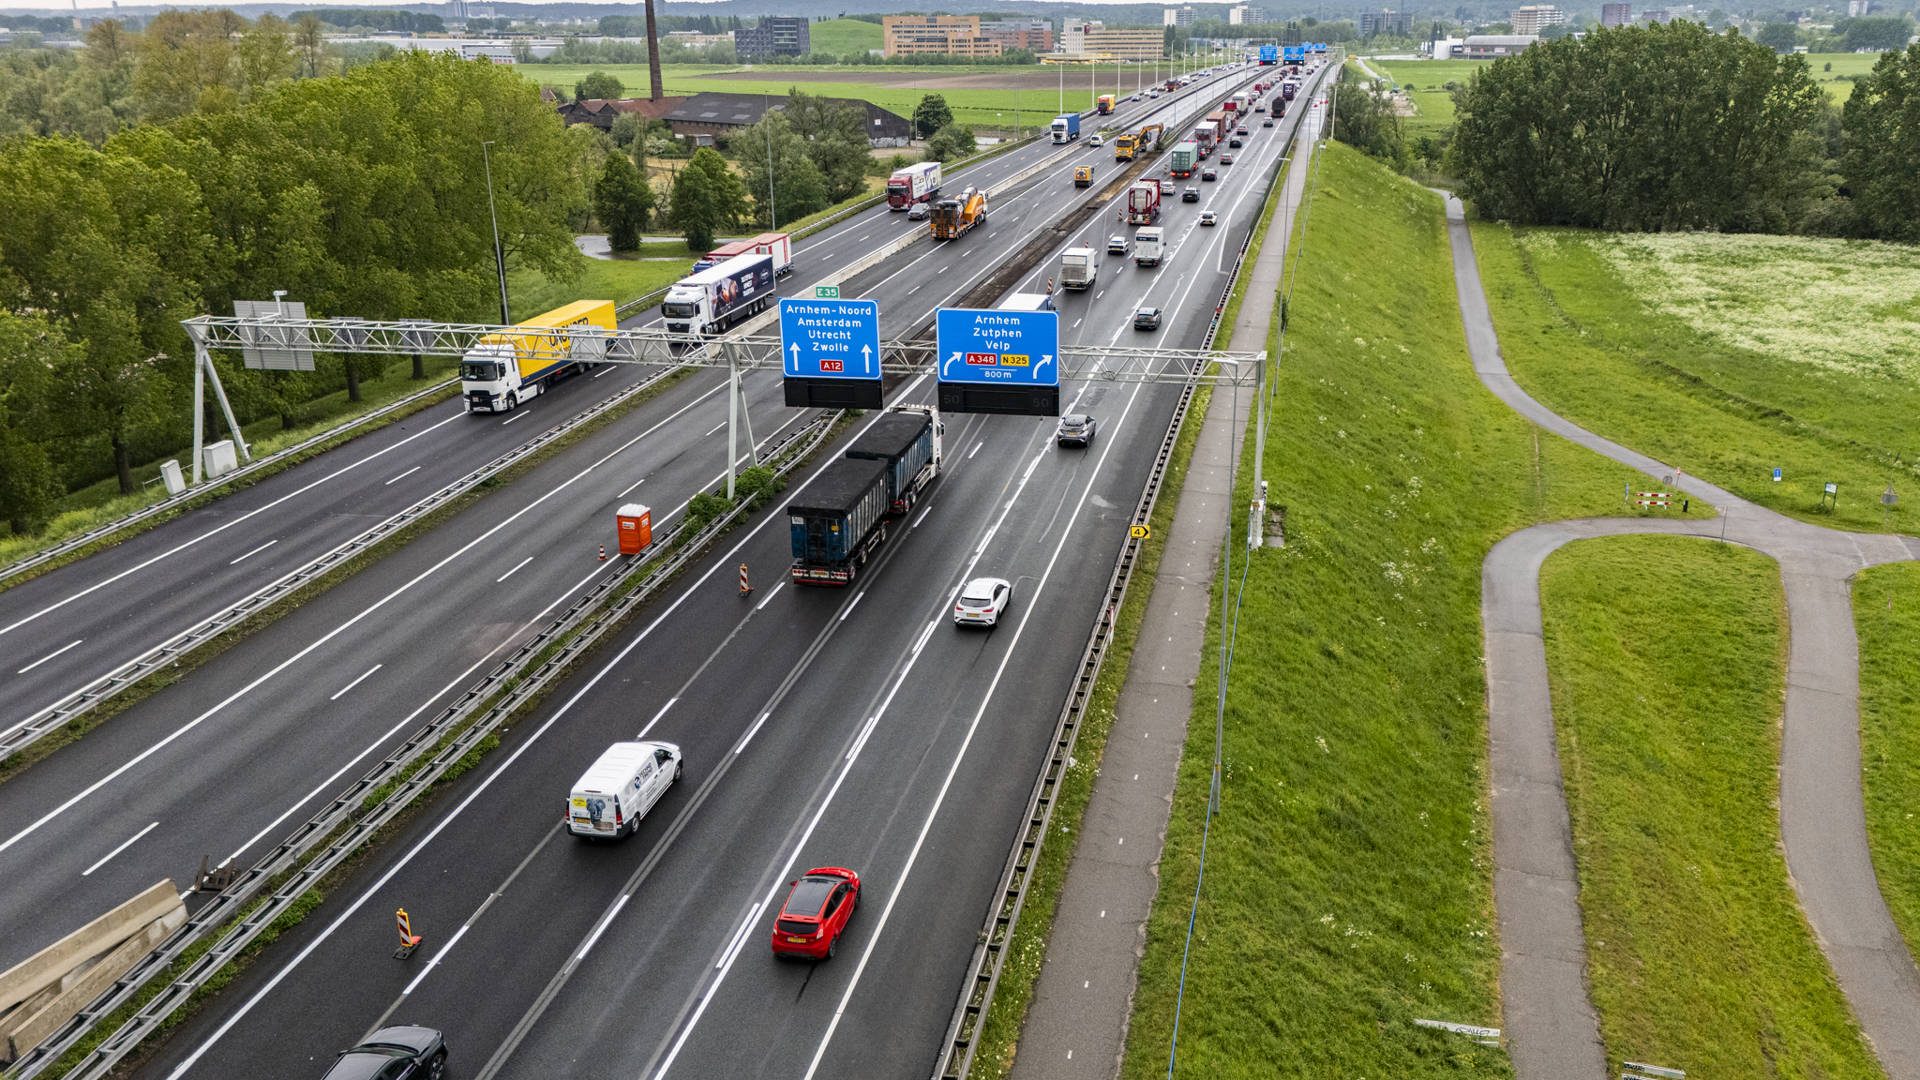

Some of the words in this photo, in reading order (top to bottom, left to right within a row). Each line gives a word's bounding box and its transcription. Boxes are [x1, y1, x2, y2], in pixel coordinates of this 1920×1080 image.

[786, 304, 872, 316] Arnhem-Noord
[797, 317, 862, 328] Amsterdam
[975, 315, 1020, 325] Arnhem
[808, 329, 852, 340] Utrecht
[973, 327, 1022, 339] Zutphen
[812, 341, 849, 352] Zwolle
[985, 340, 1011, 351] Velp
[823, 362, 842, 370] A12
